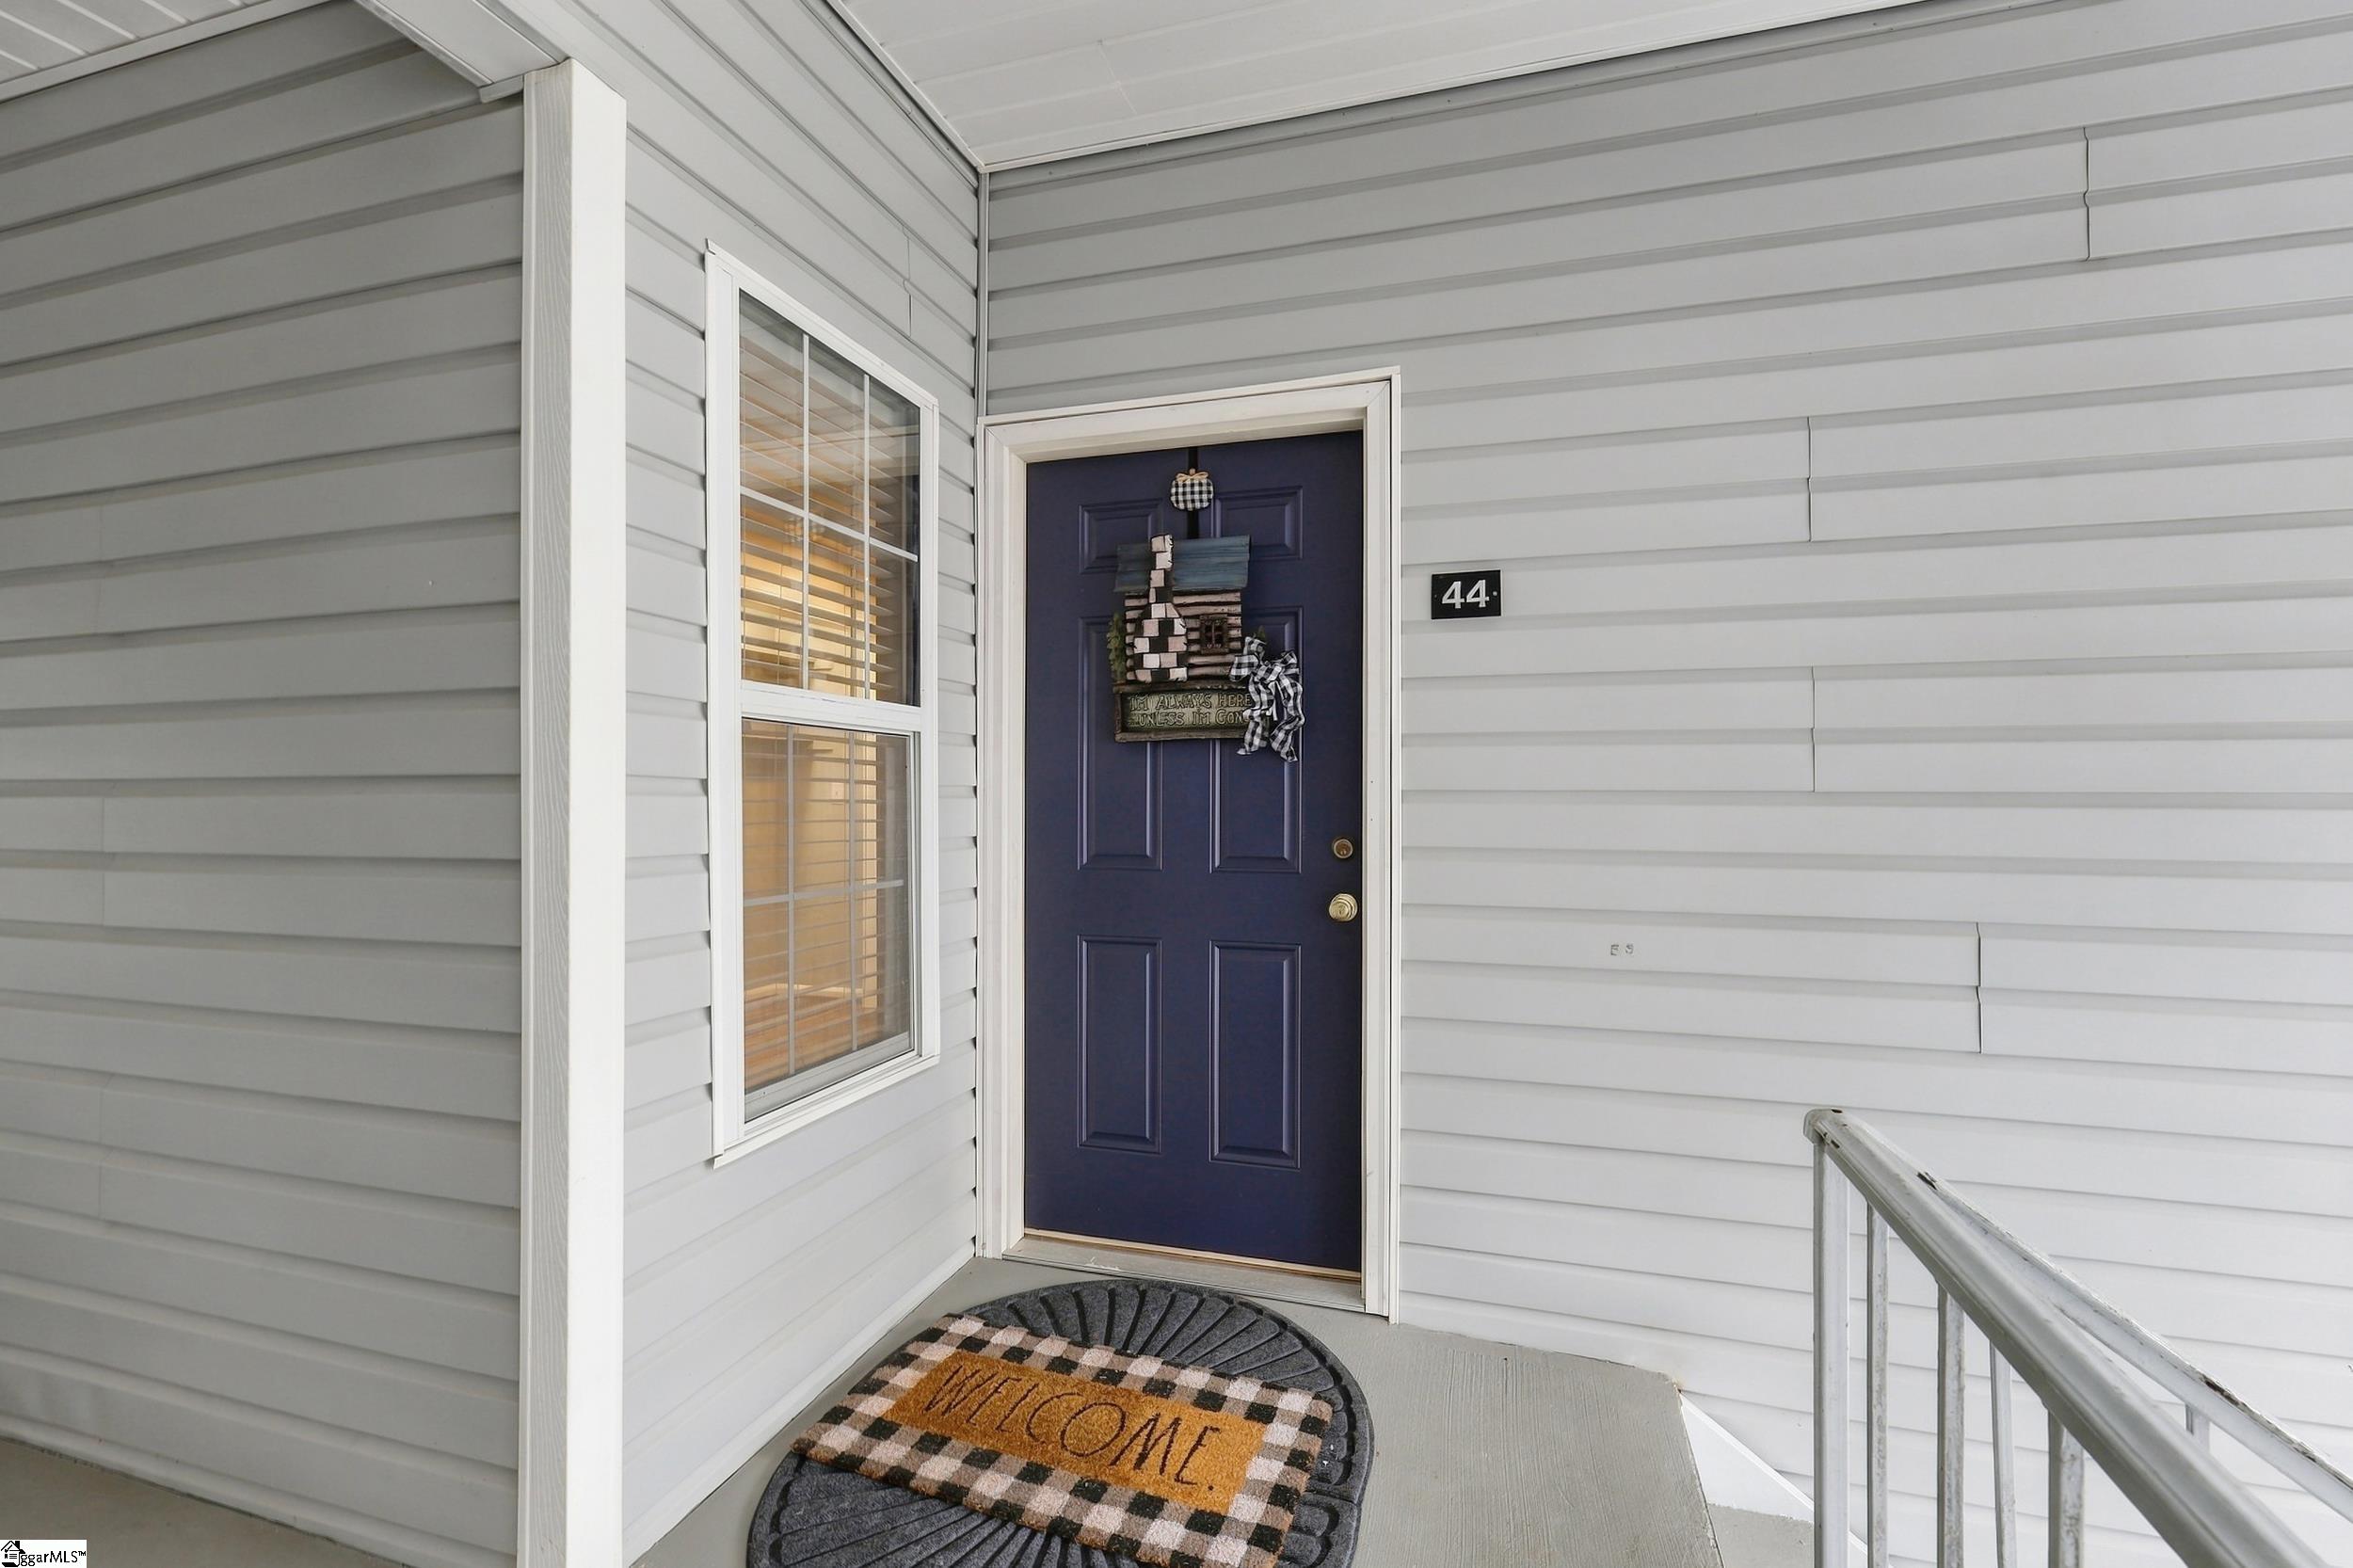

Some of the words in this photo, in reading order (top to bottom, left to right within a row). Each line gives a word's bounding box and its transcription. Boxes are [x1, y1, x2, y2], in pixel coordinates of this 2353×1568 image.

[1441, 579, 1490, 609] 44
[1156, 694, 1211, 709] ALWAYS
[1217, 692, 1251, 707] HERE
[1139, 711, 1185, 727] UNLESS
[1215, 708, 1246, 725] GON
